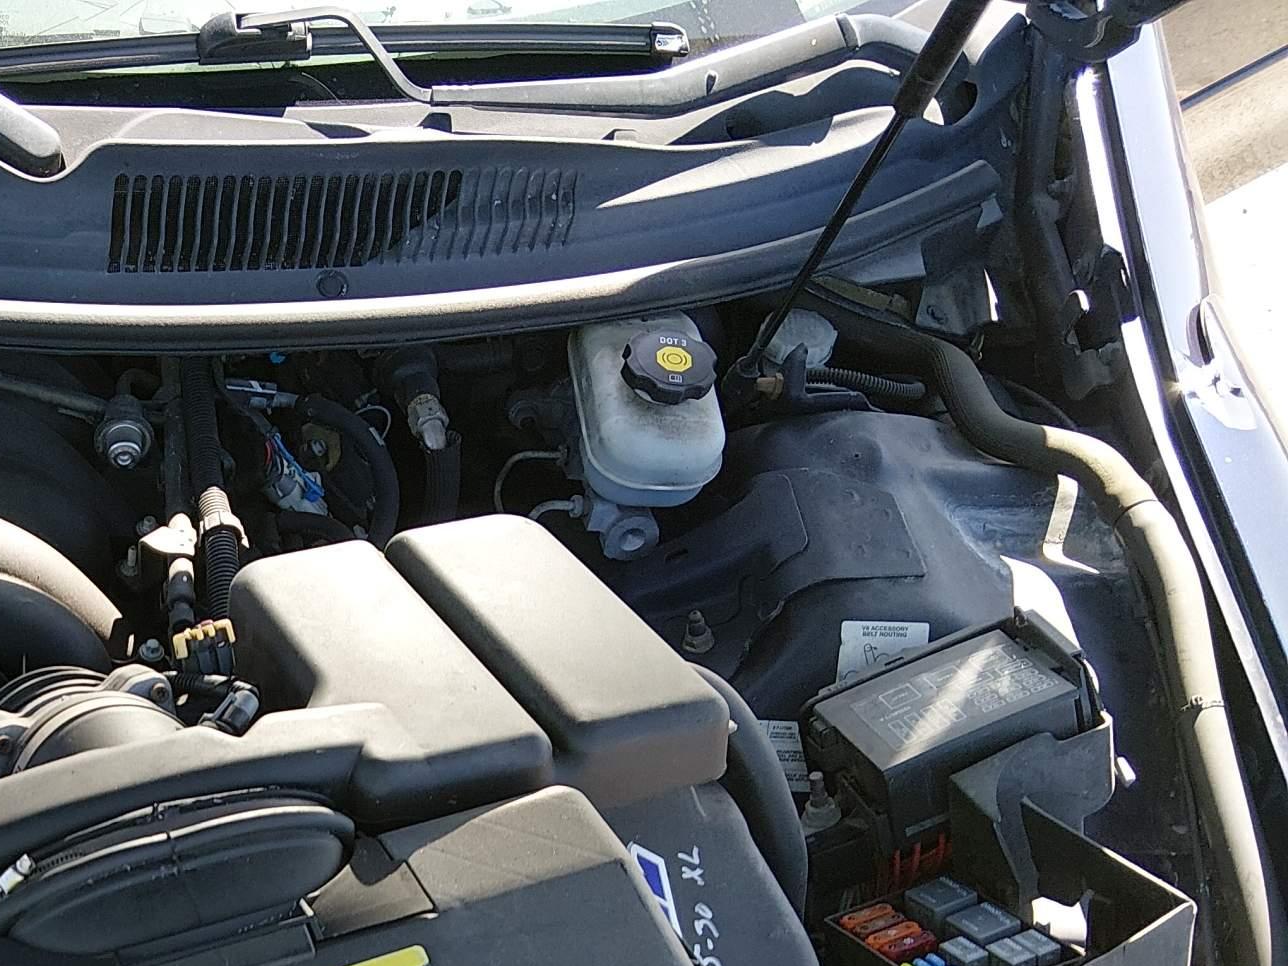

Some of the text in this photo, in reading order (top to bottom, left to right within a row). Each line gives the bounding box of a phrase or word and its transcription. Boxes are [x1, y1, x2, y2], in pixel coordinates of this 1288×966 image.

[659, 336, 687, 347] DOT 3
[677, 845, 706, 887] XL
